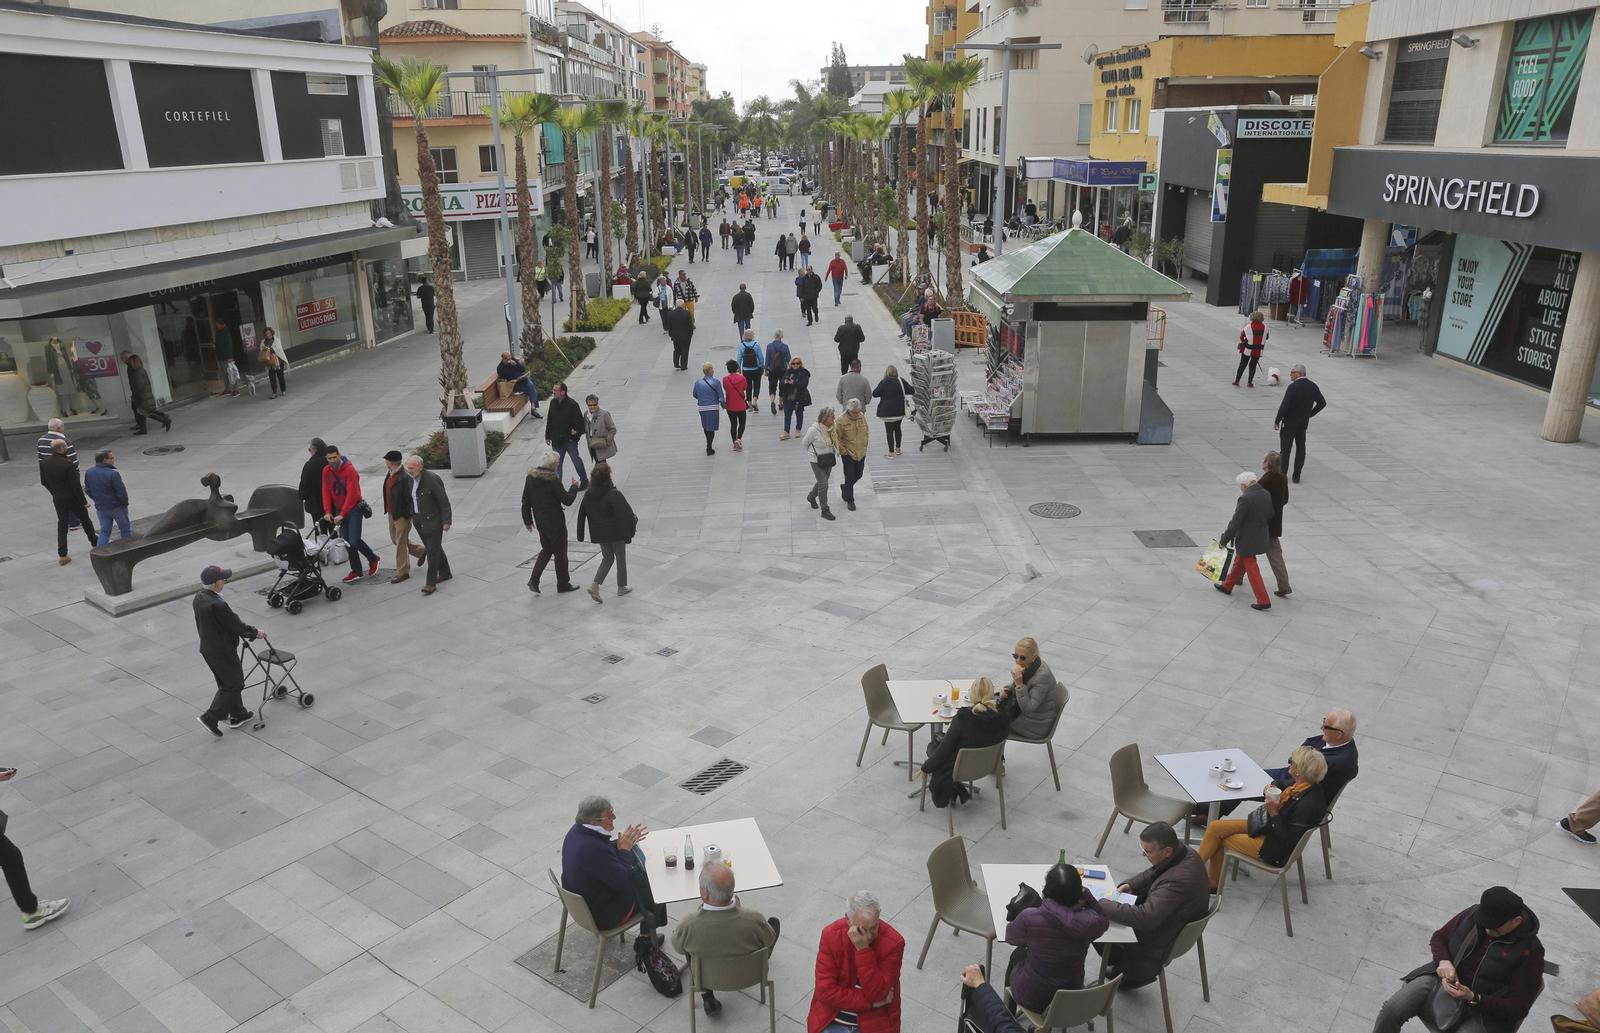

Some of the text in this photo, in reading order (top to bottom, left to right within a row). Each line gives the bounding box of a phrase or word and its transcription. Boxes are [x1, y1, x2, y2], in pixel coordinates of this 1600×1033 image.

[1407, 38, 1450, 53] SPRINGFIELD
[1517, 54, 1539, 75] FEEL
[1512, 78, 1536, 98] GOOD
[165, 111, 231, 122] CORTEFIEL
[1142, 175, 1155, 189] P
[476, 192, 534, 208] PIZZERA
[1382, 173, 1540, 218] SPRINGFIELD
[1457, 258, 1479, 275] ENJOY
[1558, 253, 1577, 272] IT'S
[1456, 274, 1474, 291] YOUR
[1553, 272, 1570, 291] ALL
[1451, 291, 1474, 308] STORE
[1537, 288, 1568, 310] ABOUT
[1542, 308, 1562, 329] LIFE.
[1529, 327, 1557, 350] STYLE.
[1517, 346, 1552, 371] STORIES.
